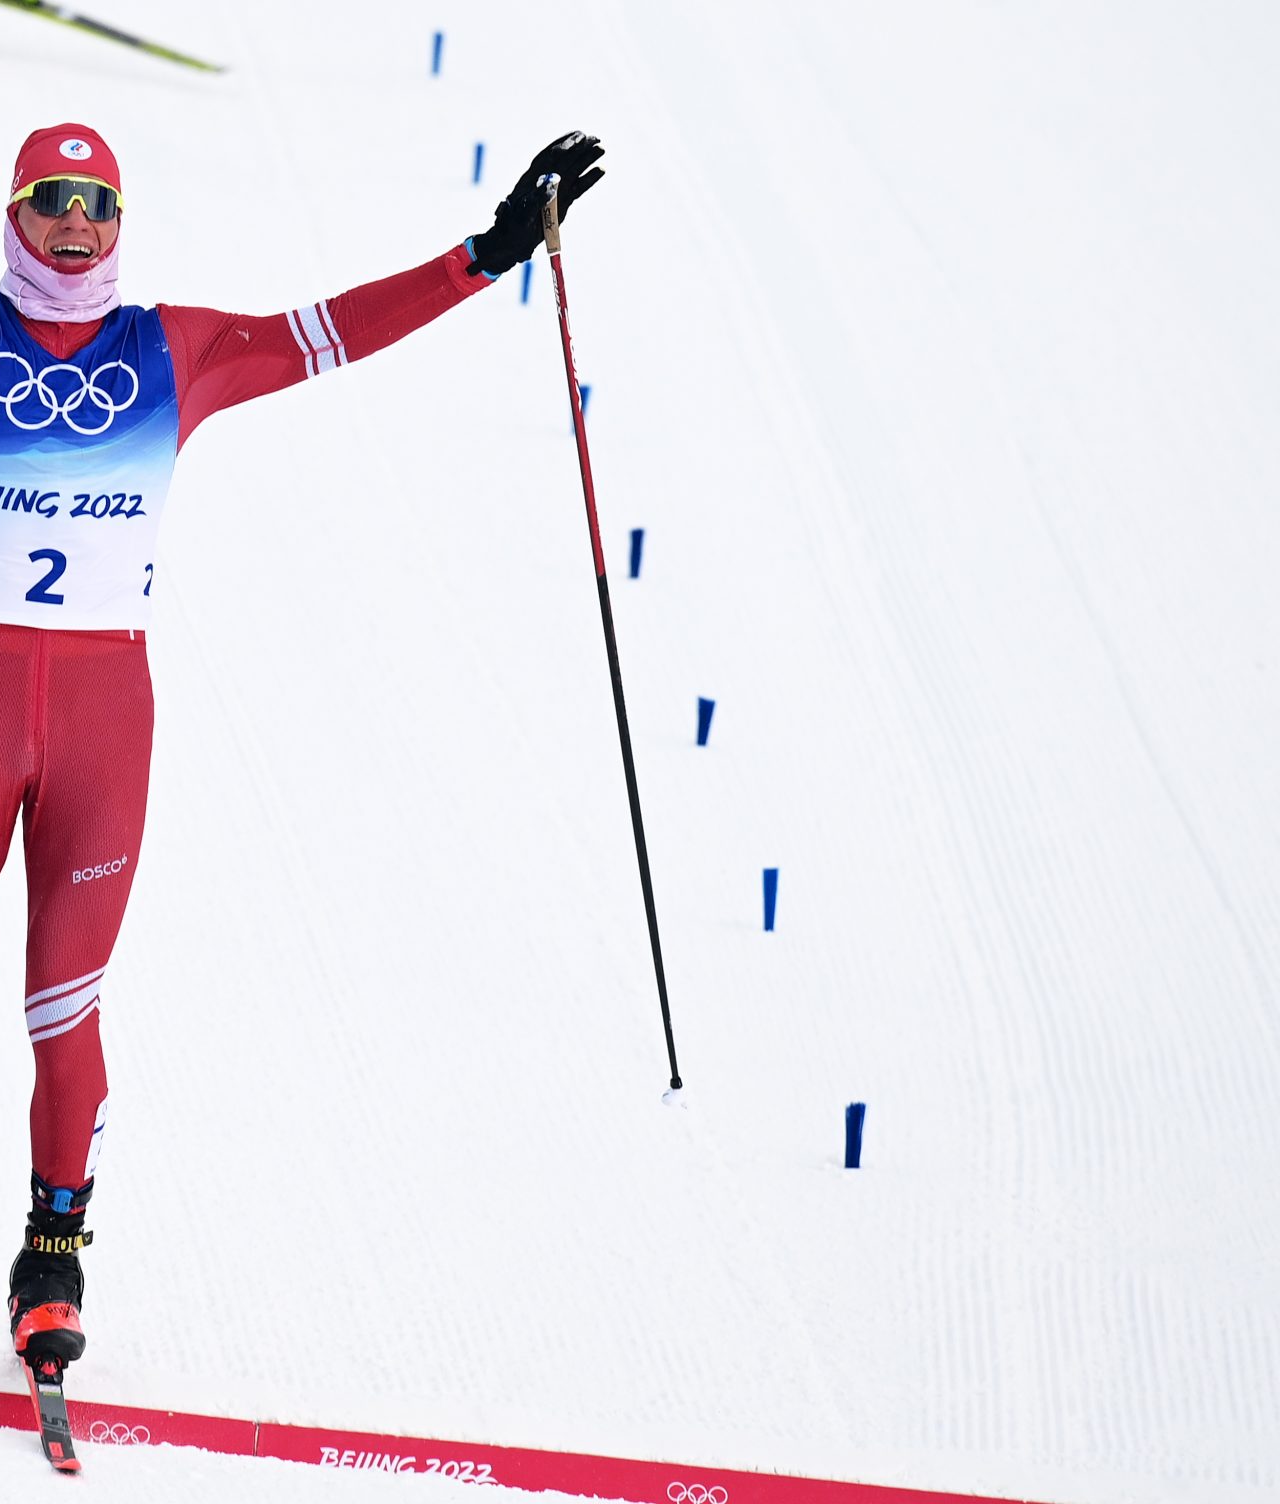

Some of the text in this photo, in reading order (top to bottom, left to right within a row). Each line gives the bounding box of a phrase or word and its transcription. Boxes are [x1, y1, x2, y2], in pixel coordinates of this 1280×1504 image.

[70, 493, 147, 519] 2022
[25, 548, 67, 605] 2
[72, 860, 122, 884] BOSCO
[424, 1458, 499, 1485] 2022
